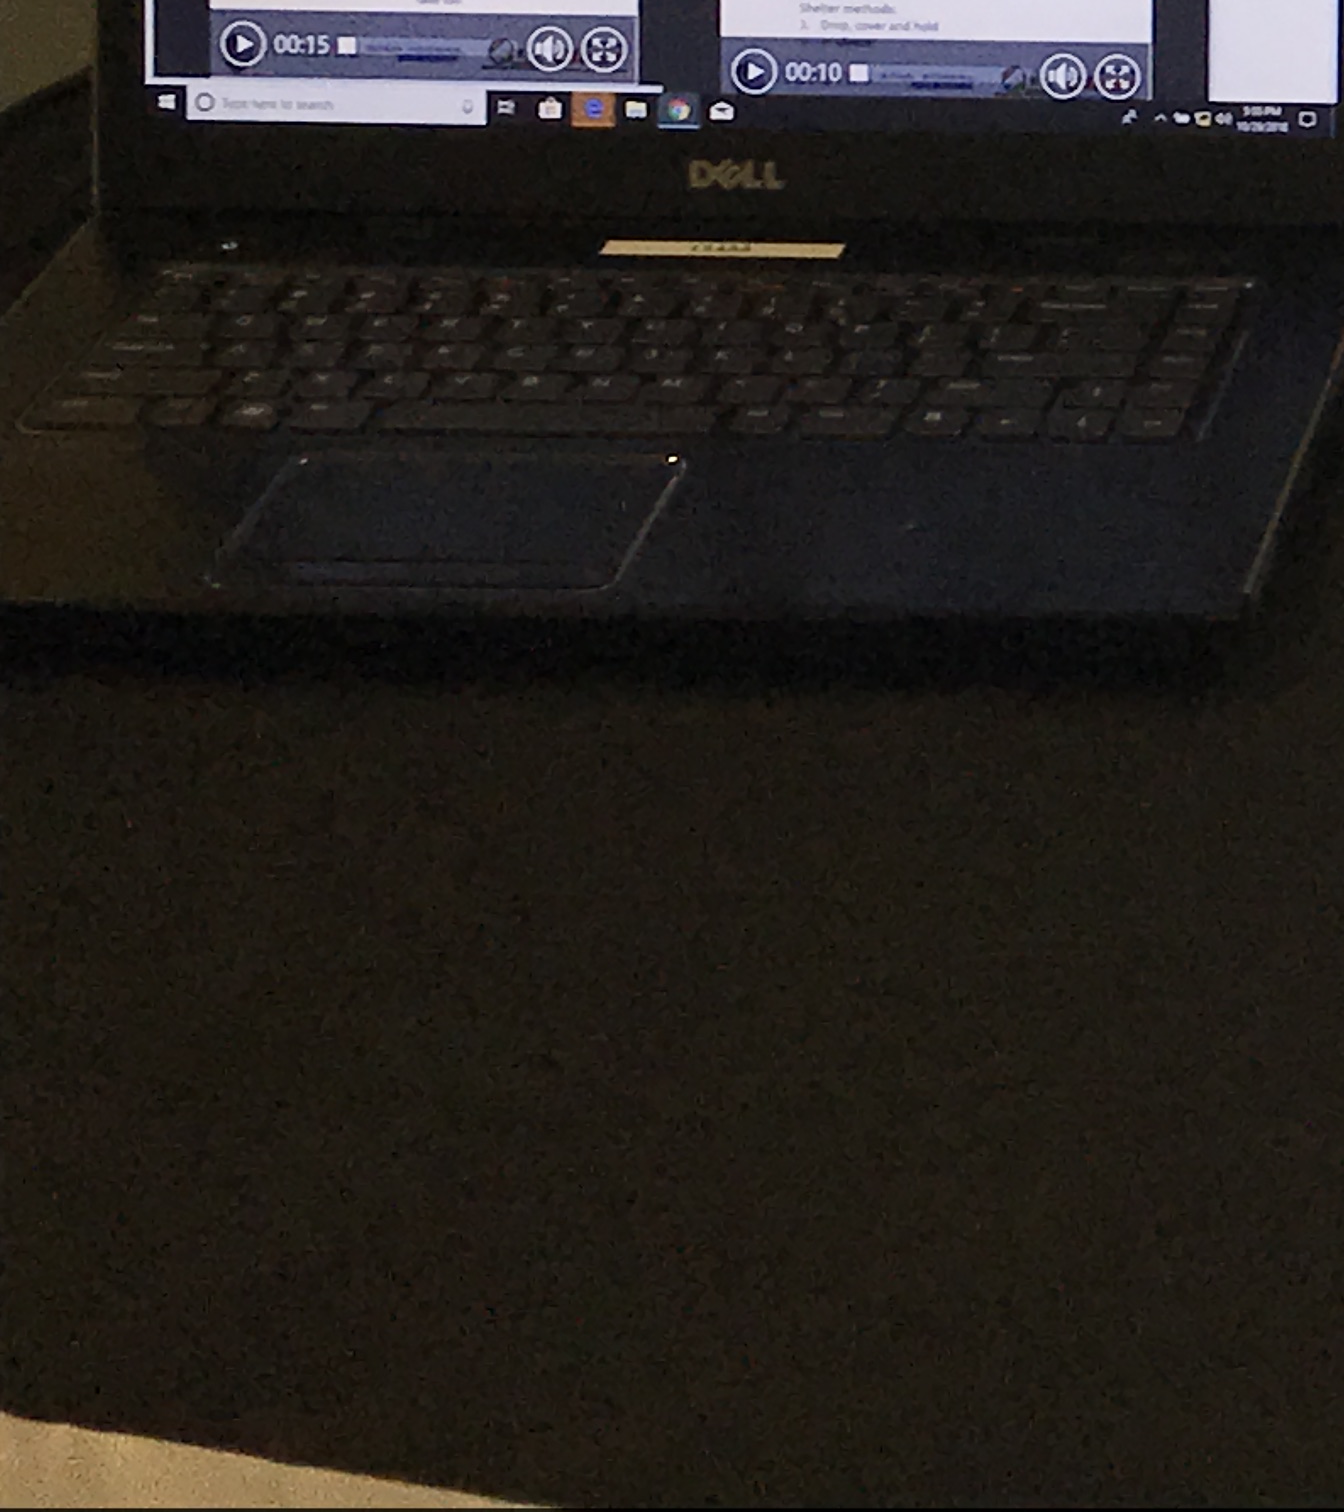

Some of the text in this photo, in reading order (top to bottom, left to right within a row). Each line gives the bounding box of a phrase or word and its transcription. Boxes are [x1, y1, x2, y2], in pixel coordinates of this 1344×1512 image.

[273, 34, 331, 55] 00:15
[785, 61, 843, 83] 00:10
[688, 158, 785, 190] DELL
